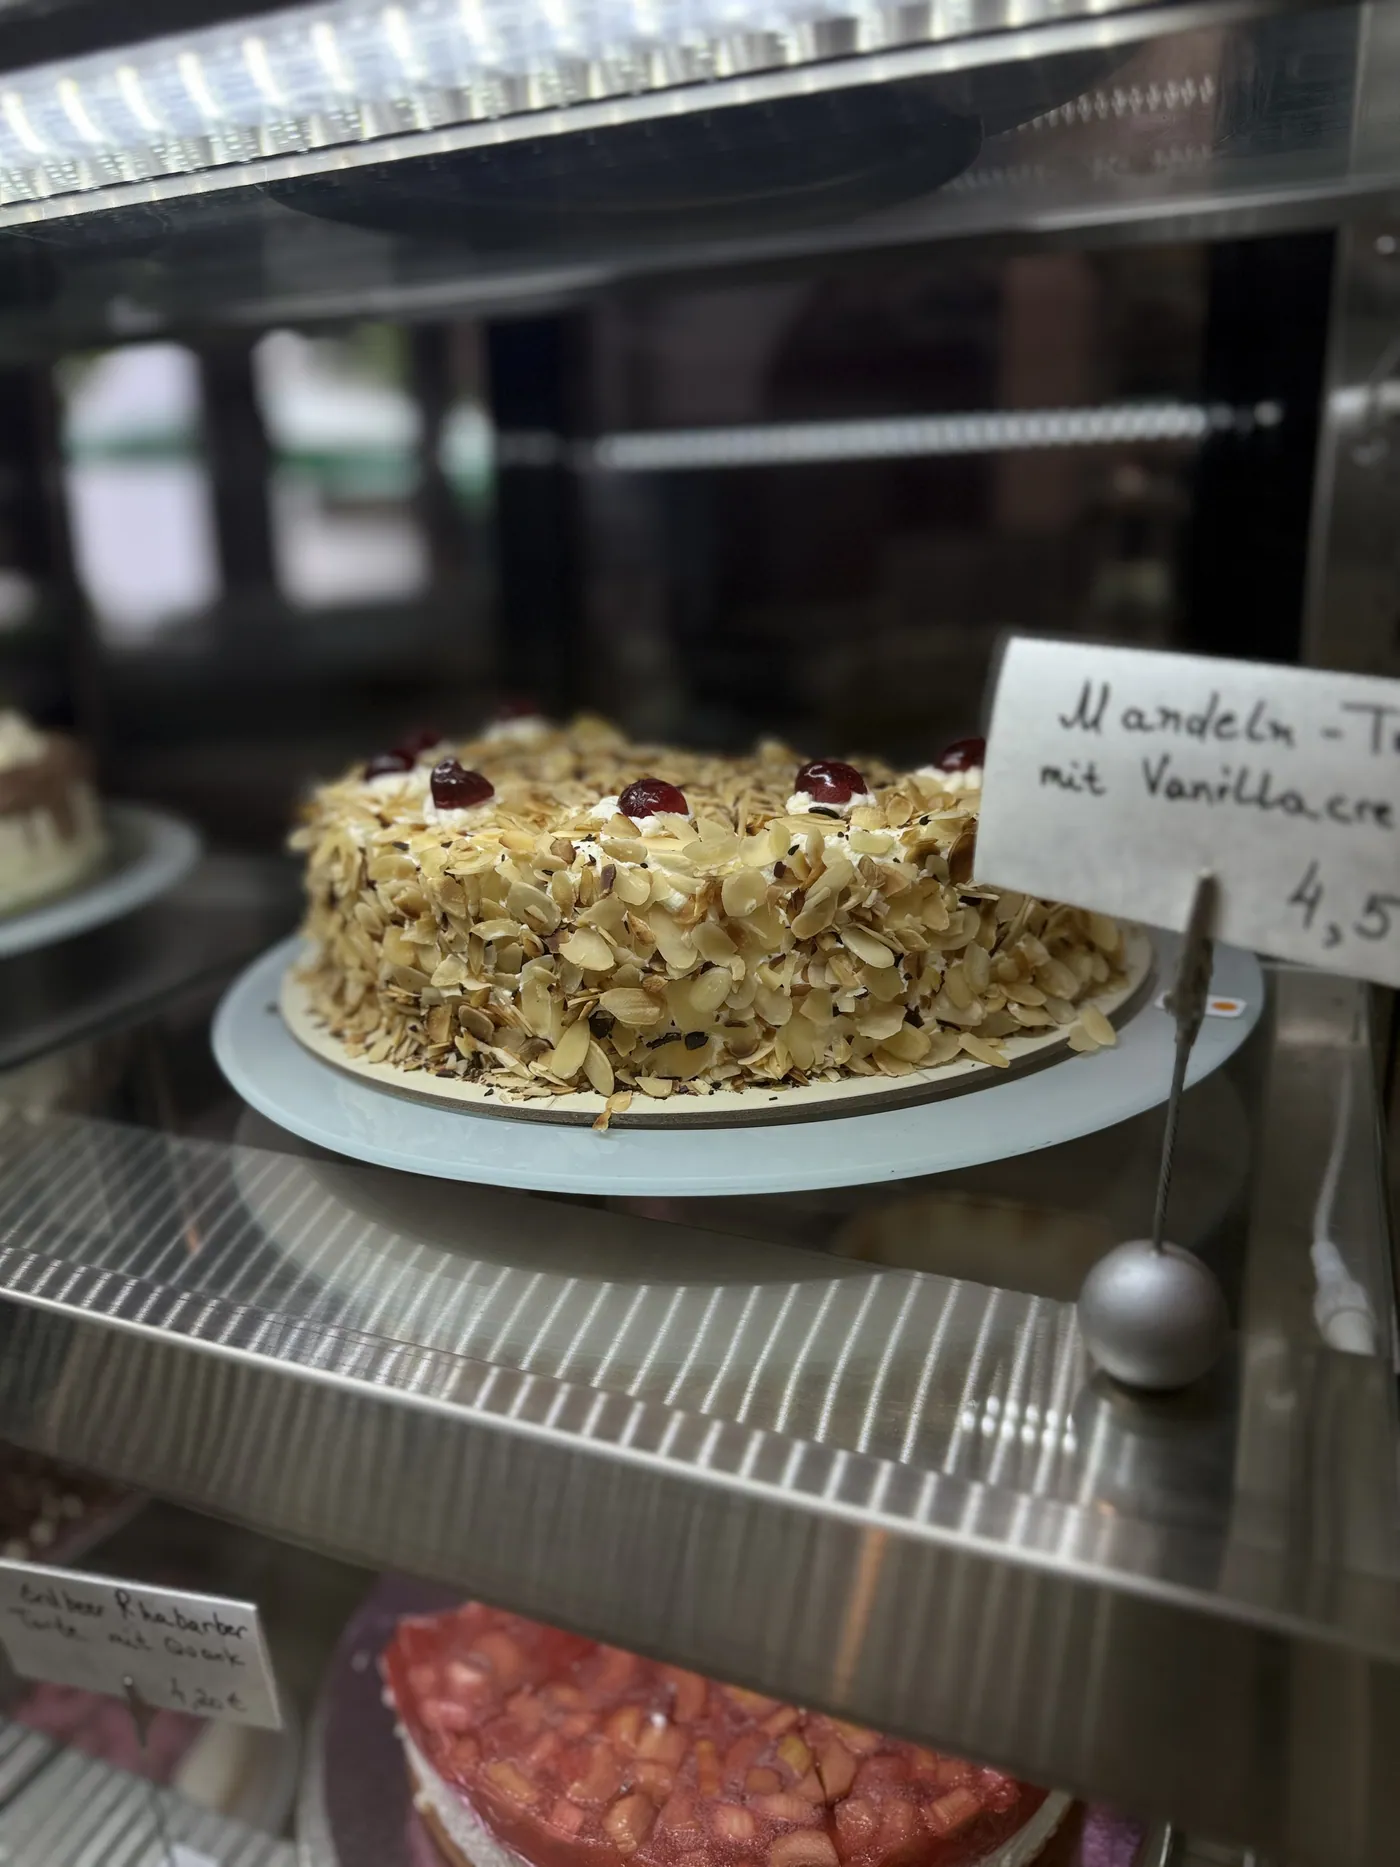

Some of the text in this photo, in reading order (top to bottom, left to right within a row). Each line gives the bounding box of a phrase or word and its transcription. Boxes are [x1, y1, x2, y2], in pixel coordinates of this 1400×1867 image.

[1057, 678, 1296, 748] Mandeln
[1039, 760, 1106, 797] mit
[107, 1631, 154, 1653] mit
